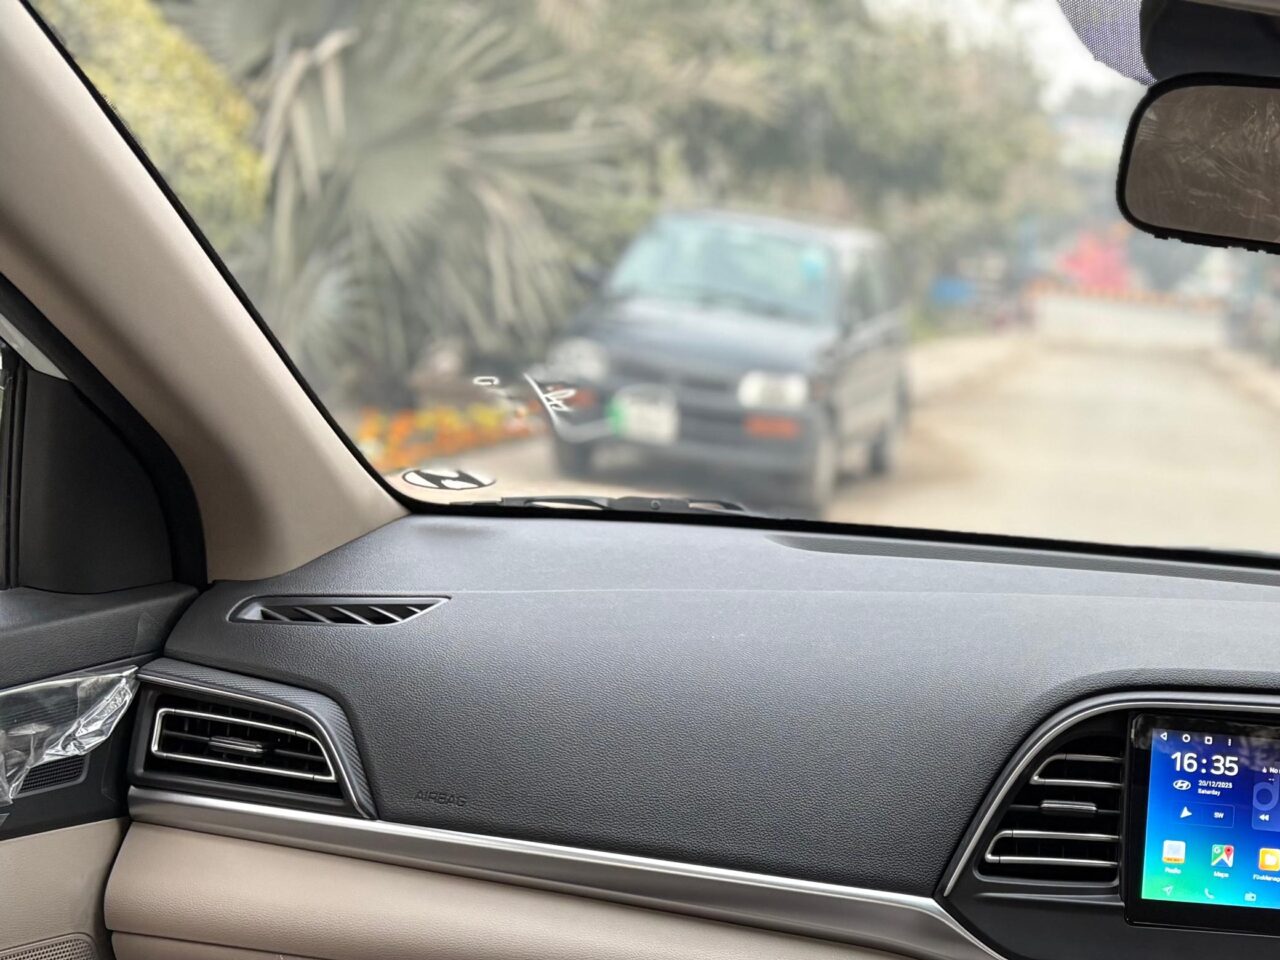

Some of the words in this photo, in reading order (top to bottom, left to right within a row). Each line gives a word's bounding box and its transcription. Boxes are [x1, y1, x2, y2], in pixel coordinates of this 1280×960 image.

[1170, 751, 1239, 777] 16:35
[1269, 766, 1279, 774] No
[1197, 788, 1221, 797] Saturday
